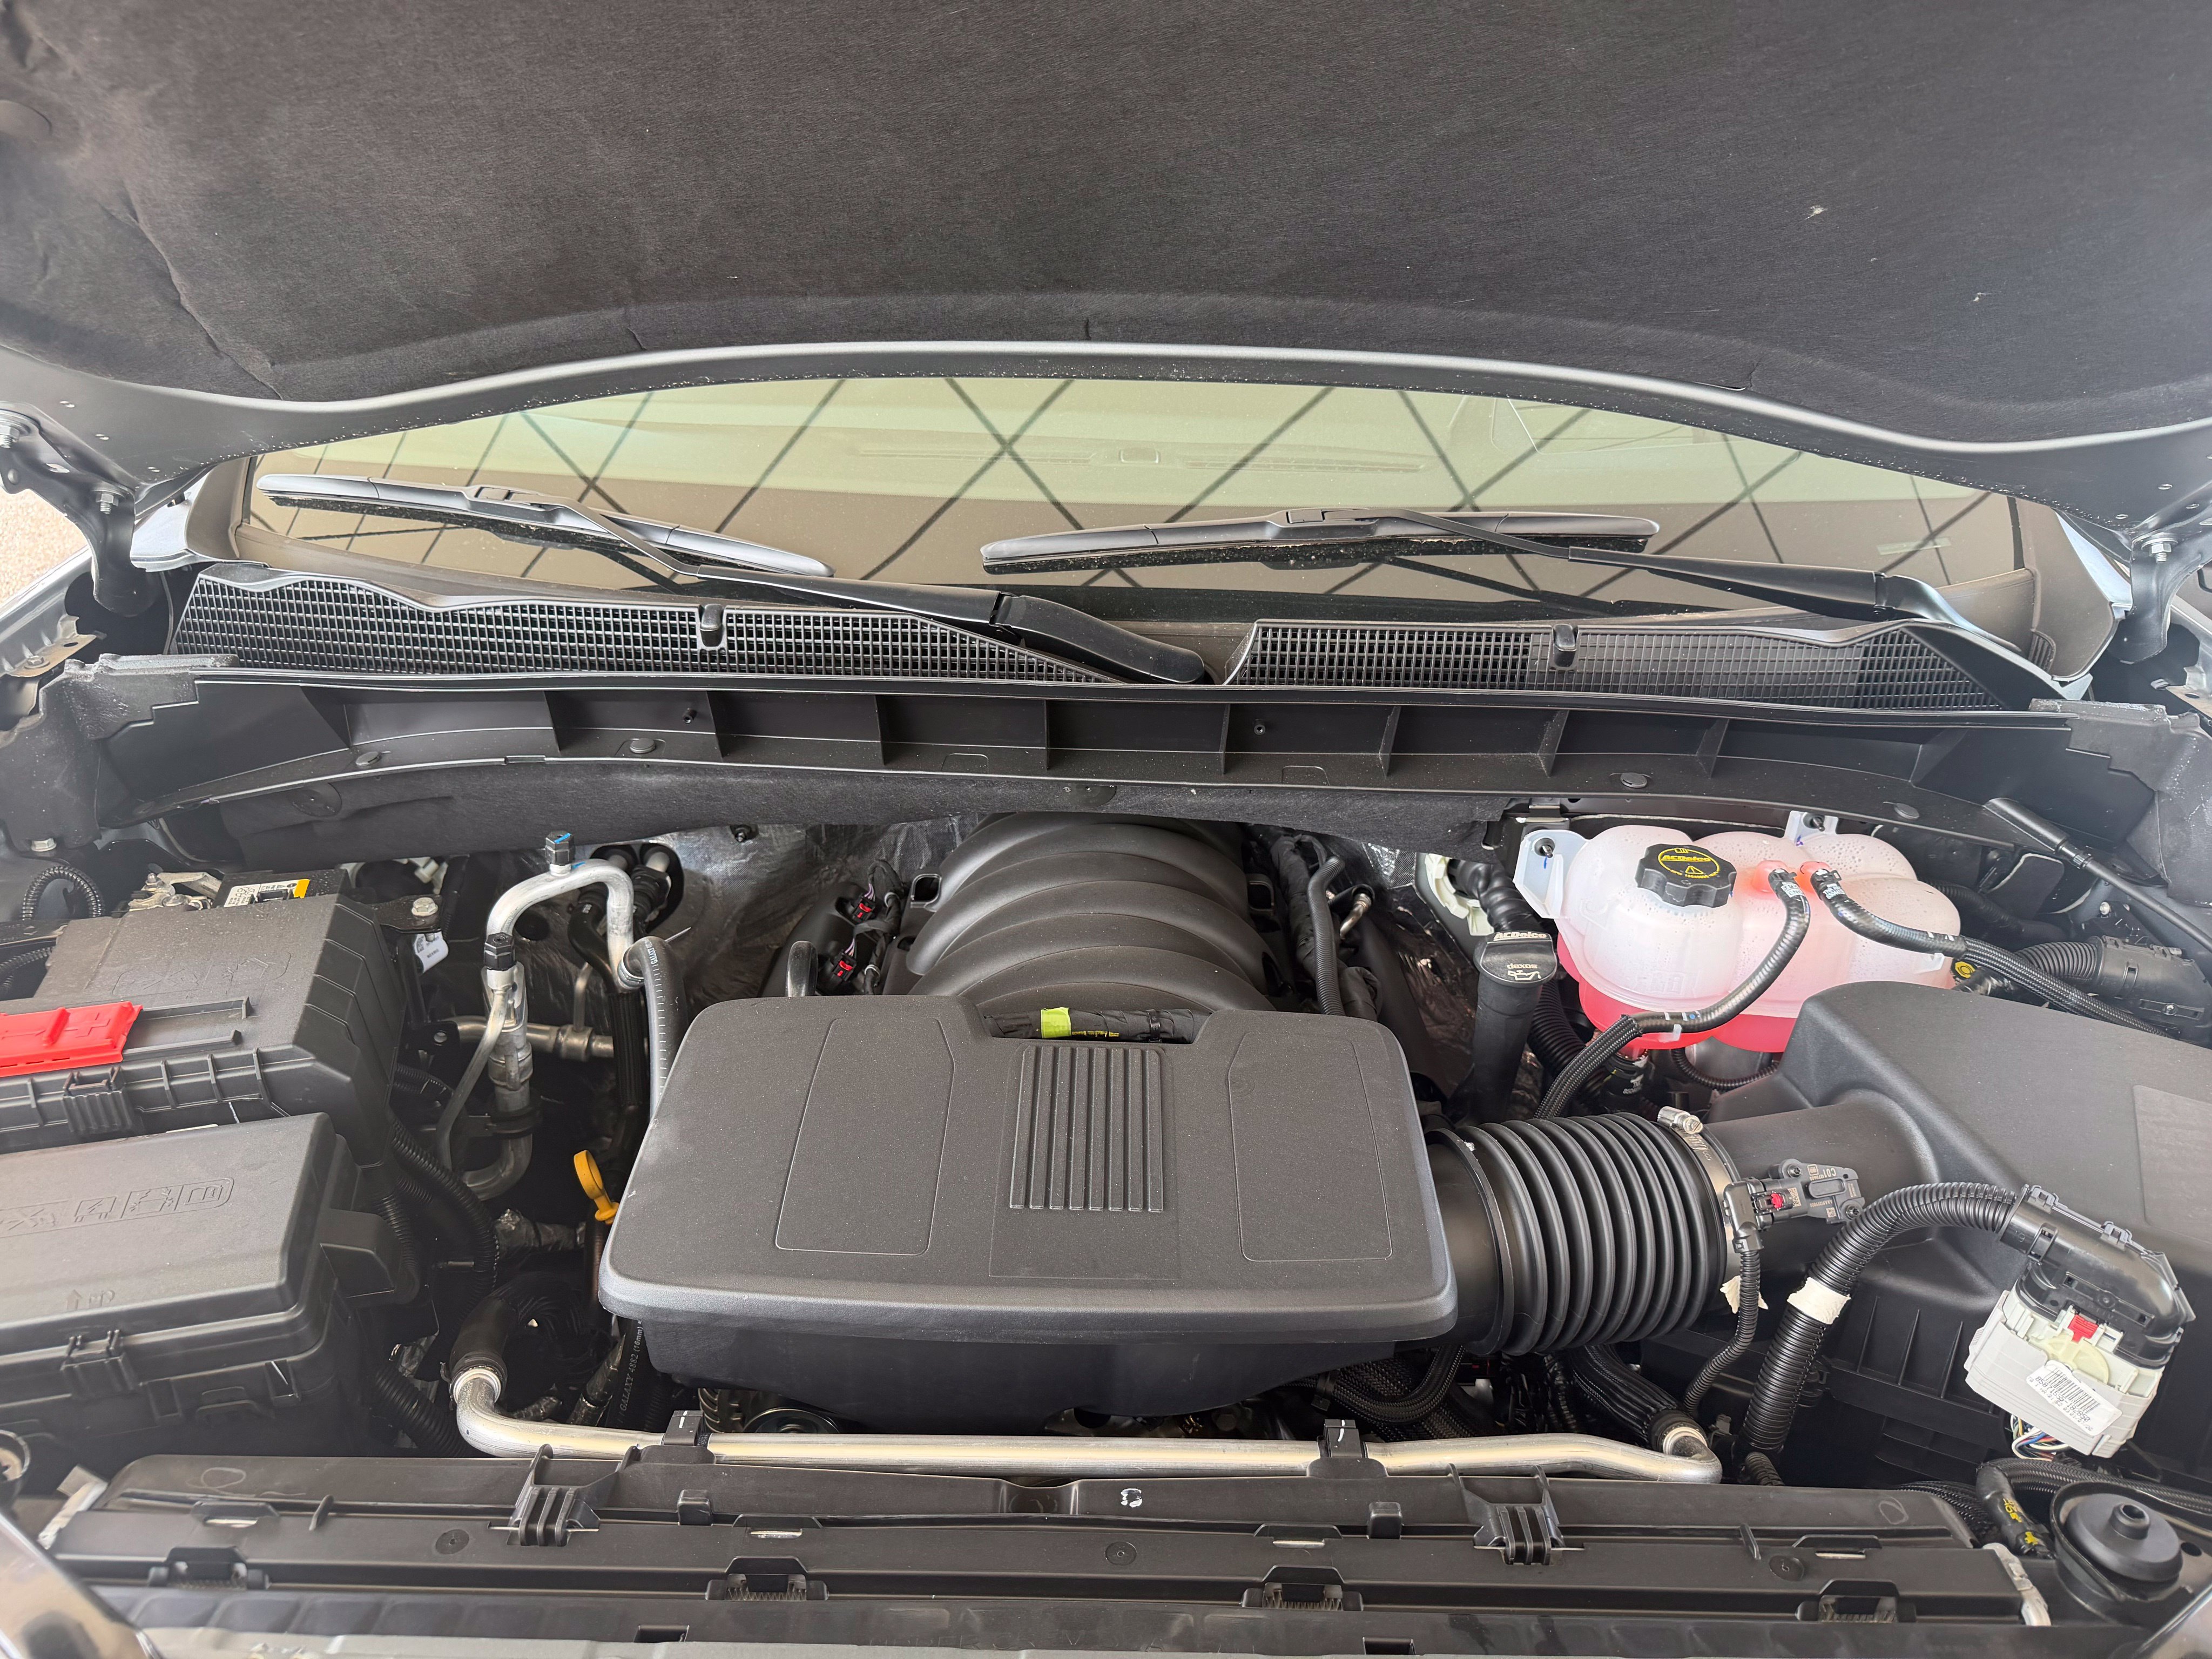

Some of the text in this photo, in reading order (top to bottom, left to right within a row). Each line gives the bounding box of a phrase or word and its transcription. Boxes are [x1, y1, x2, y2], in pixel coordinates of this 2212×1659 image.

[1493, 932, 1547, 941] ACDelco
[620, 1326, 644, 1411] GALAXY 4882 (16mm)
